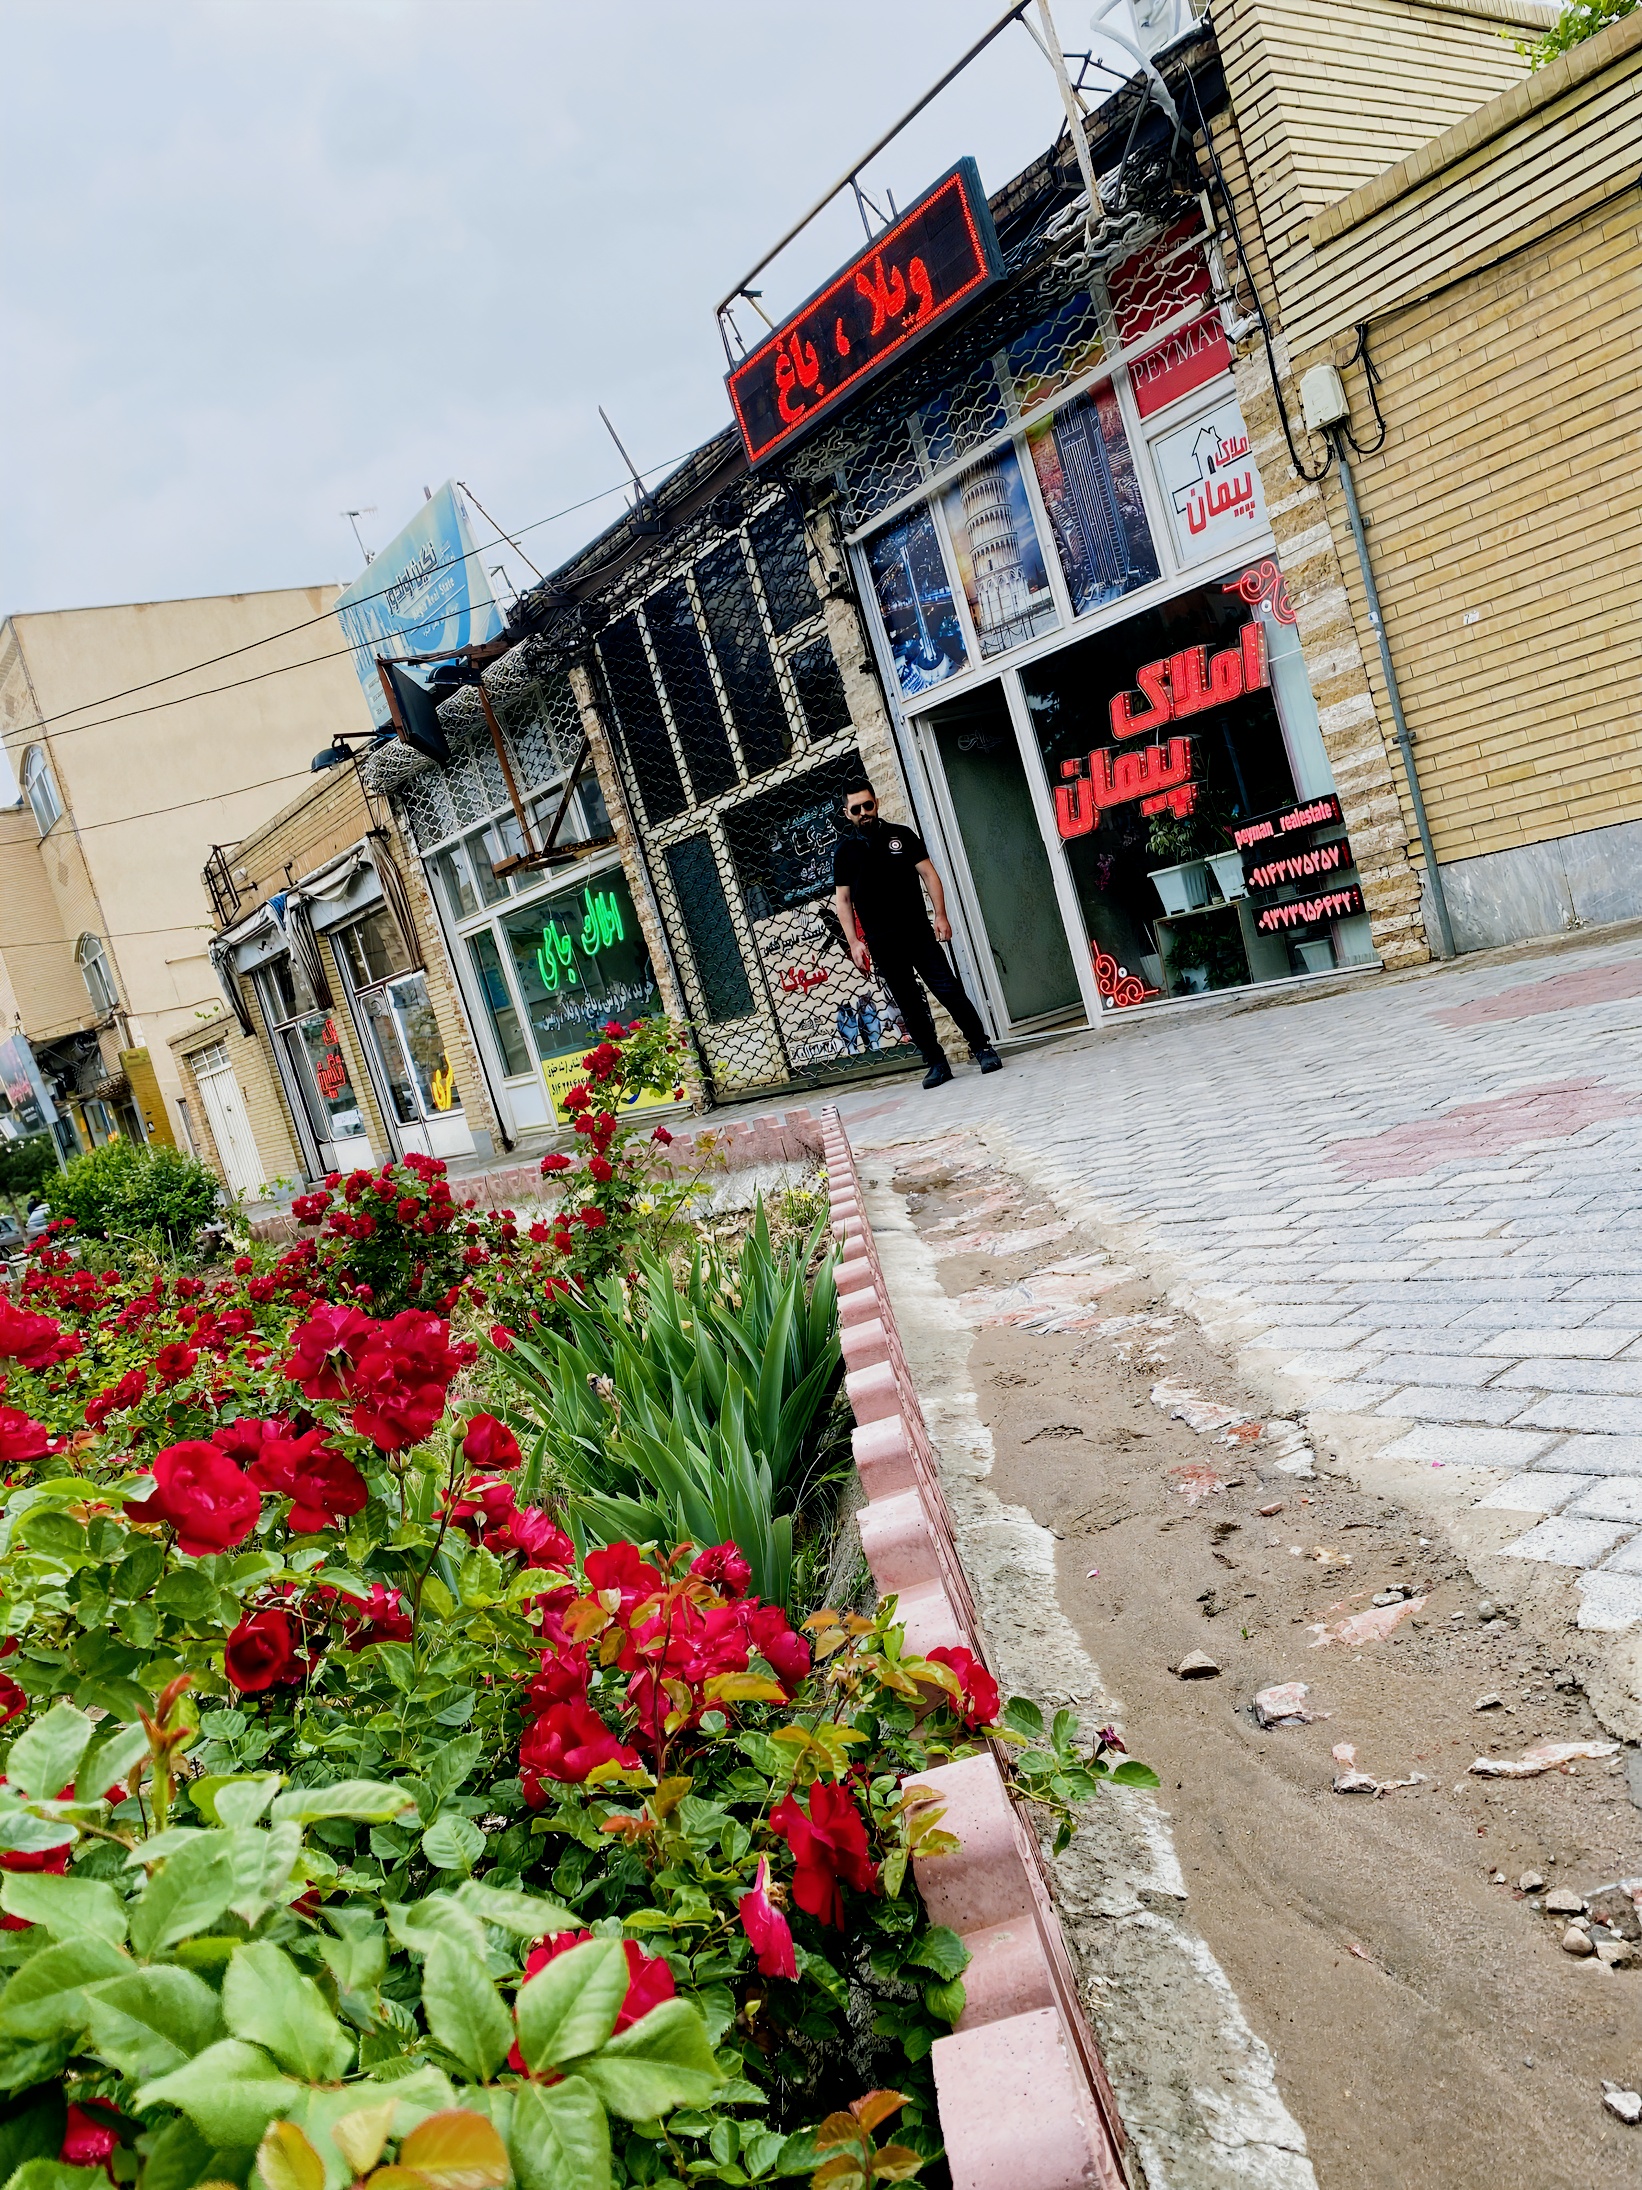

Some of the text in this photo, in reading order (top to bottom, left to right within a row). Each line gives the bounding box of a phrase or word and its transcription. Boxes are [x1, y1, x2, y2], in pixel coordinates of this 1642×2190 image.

[855, 254, 935, 336] ویلا
[775, 331, 825, 425] باغ
[1215, 435, 1251, 467] ملاک
[1186, 472, 1256, 535] پیمان
[1109, 620, 1271, 740] املاک
[1052, 735, 1199, 839] پیمان
